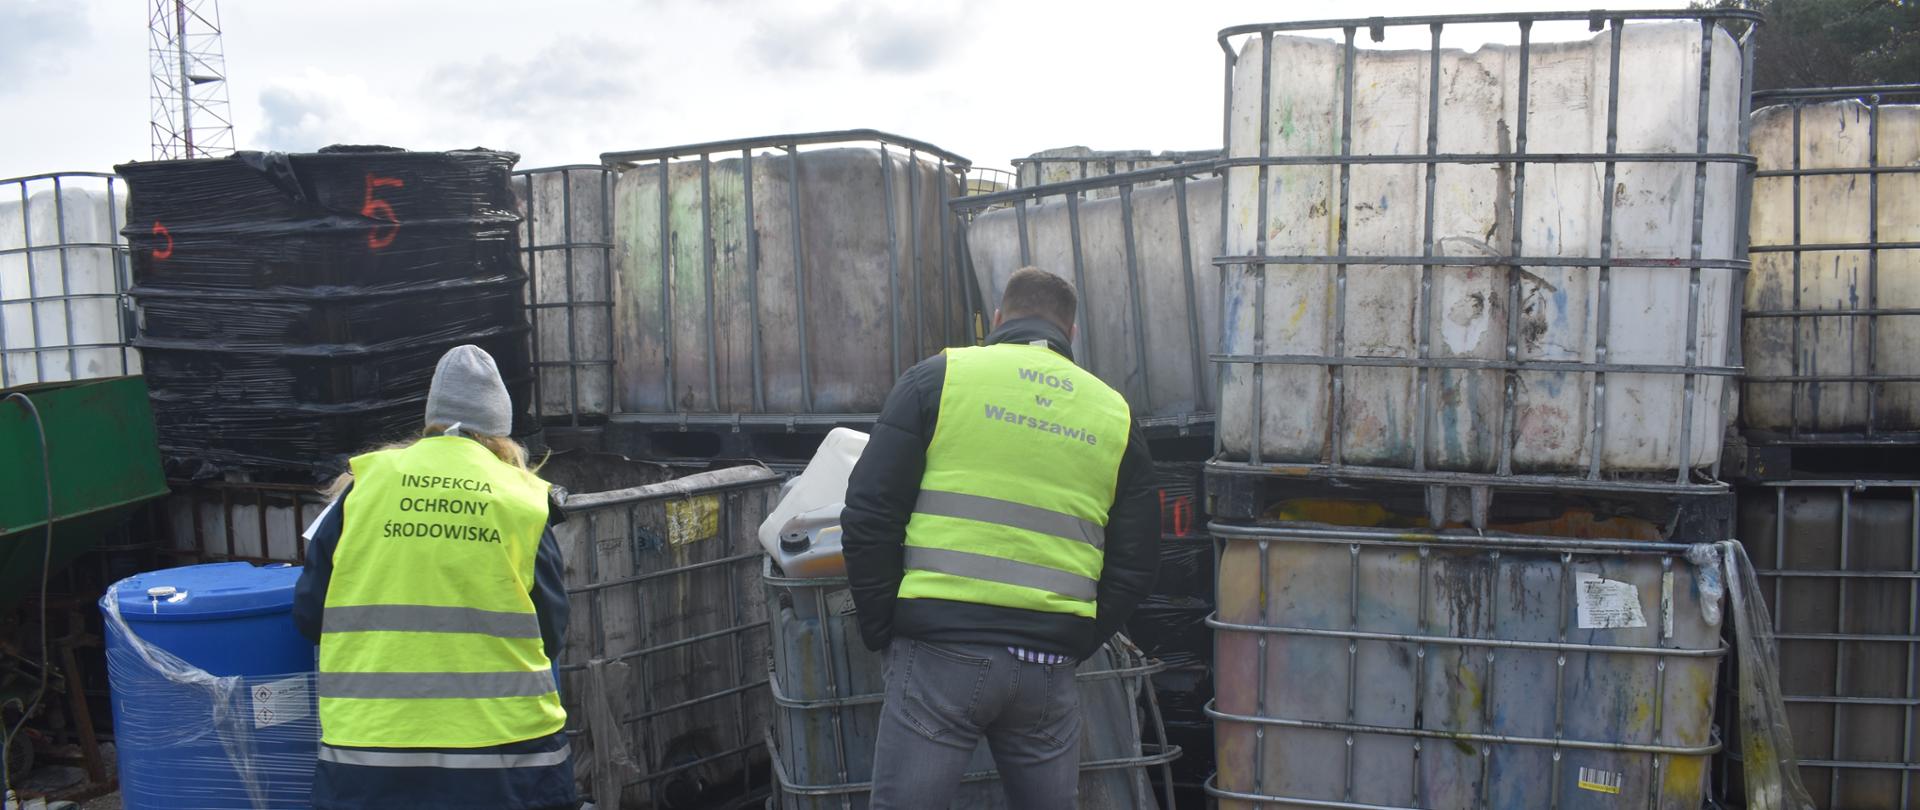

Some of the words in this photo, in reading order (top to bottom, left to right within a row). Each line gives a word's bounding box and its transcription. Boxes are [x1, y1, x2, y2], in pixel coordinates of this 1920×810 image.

[361, 174, 404, 249] 5
[1018, 367, 1074, 393] WIOŚ
[1035, 394, 1053, 408] w
[984, 403, 1097, 446] Warszawie
[401, 473, 493, 494] INSPEKCJA
[399, 497, 489, 516] OCHRONY
[383, 519, 502, 544] ŚRODOWISKA
